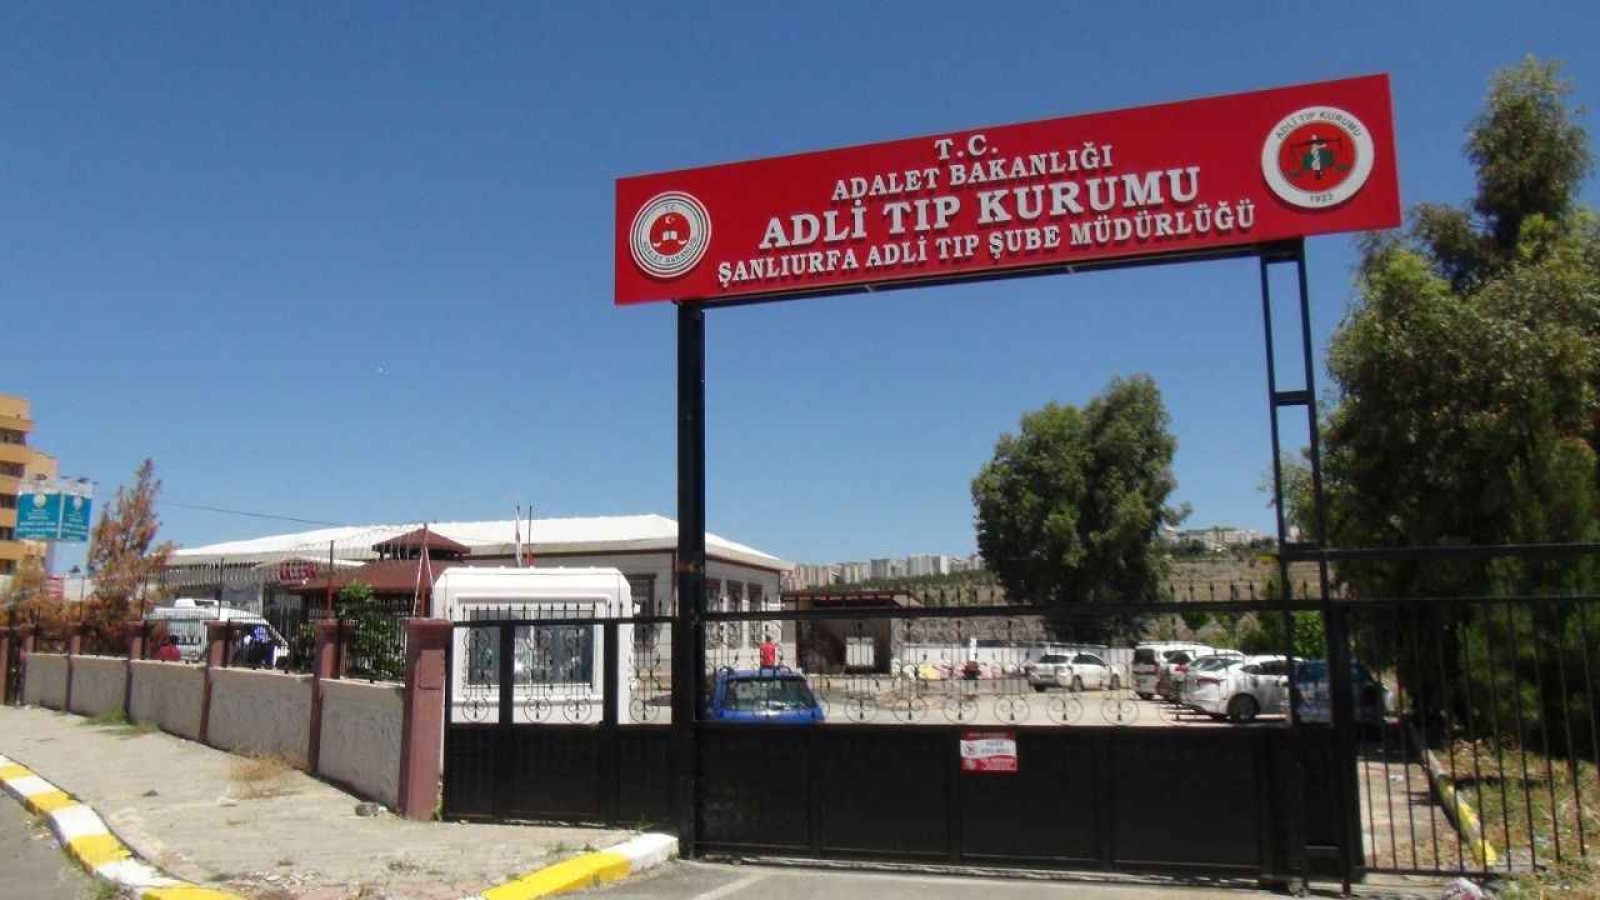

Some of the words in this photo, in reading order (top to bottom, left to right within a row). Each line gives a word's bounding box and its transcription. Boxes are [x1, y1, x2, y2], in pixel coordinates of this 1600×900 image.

[832, 168, 940, 202] ADALET
[949, 142, 1113, 187] BAKANLIĞI
[934, 134, 998, 161] T.C.
[718, 248, 860, 289] ŞANLIURFA
[865, 235, 927, 268] ADLİ
[935, 234, 980, 260] TIP
[989, 225, 1061, 260] ŞUBE
[1069, 199, 1256, 246] MÜDÜRLÜĞÜ
[759, 199, 868, 250] ADLİ
[883, 195, 961, 234] TIP
[977, 166, 1201, 225] KURUMU
